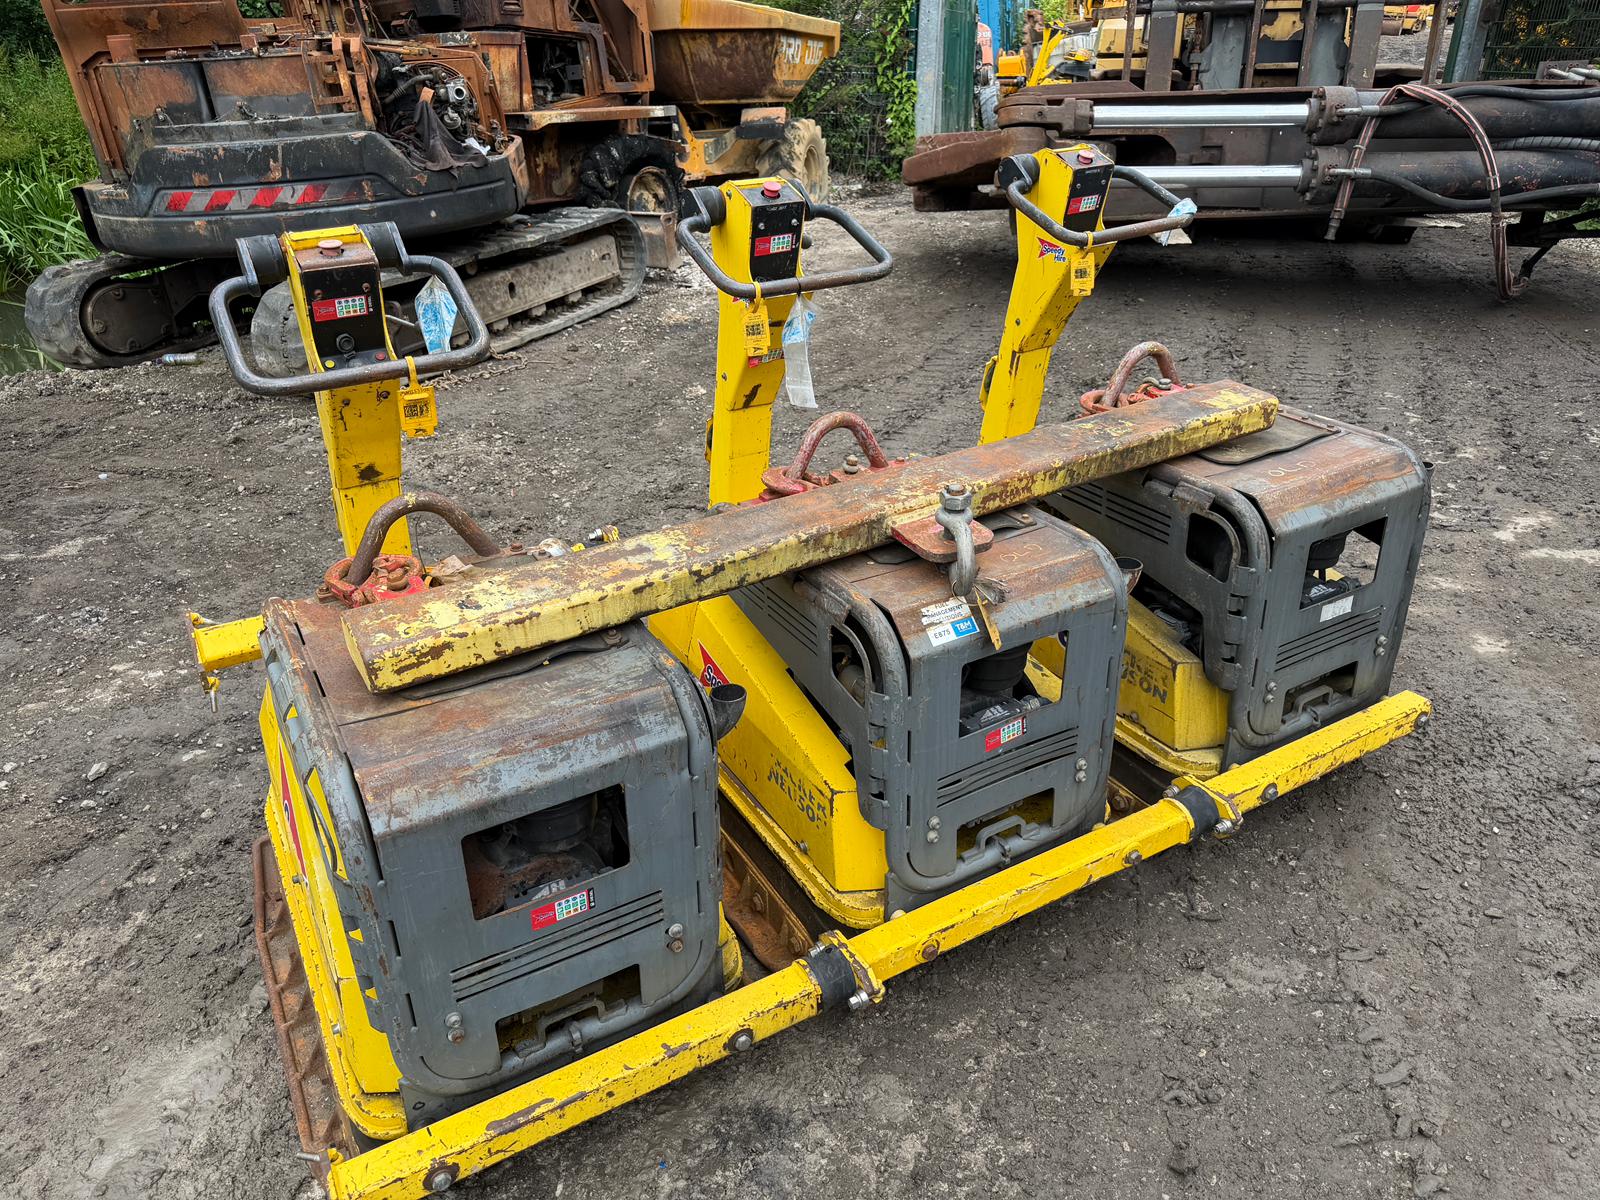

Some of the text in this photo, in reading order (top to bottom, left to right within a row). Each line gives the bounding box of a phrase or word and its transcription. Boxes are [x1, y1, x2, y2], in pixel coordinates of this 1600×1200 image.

[1043, 243, 1065, 256] Speedy
[1054, 254, 1067, 263] Hire
[955, 620, 972, 631] T&M
